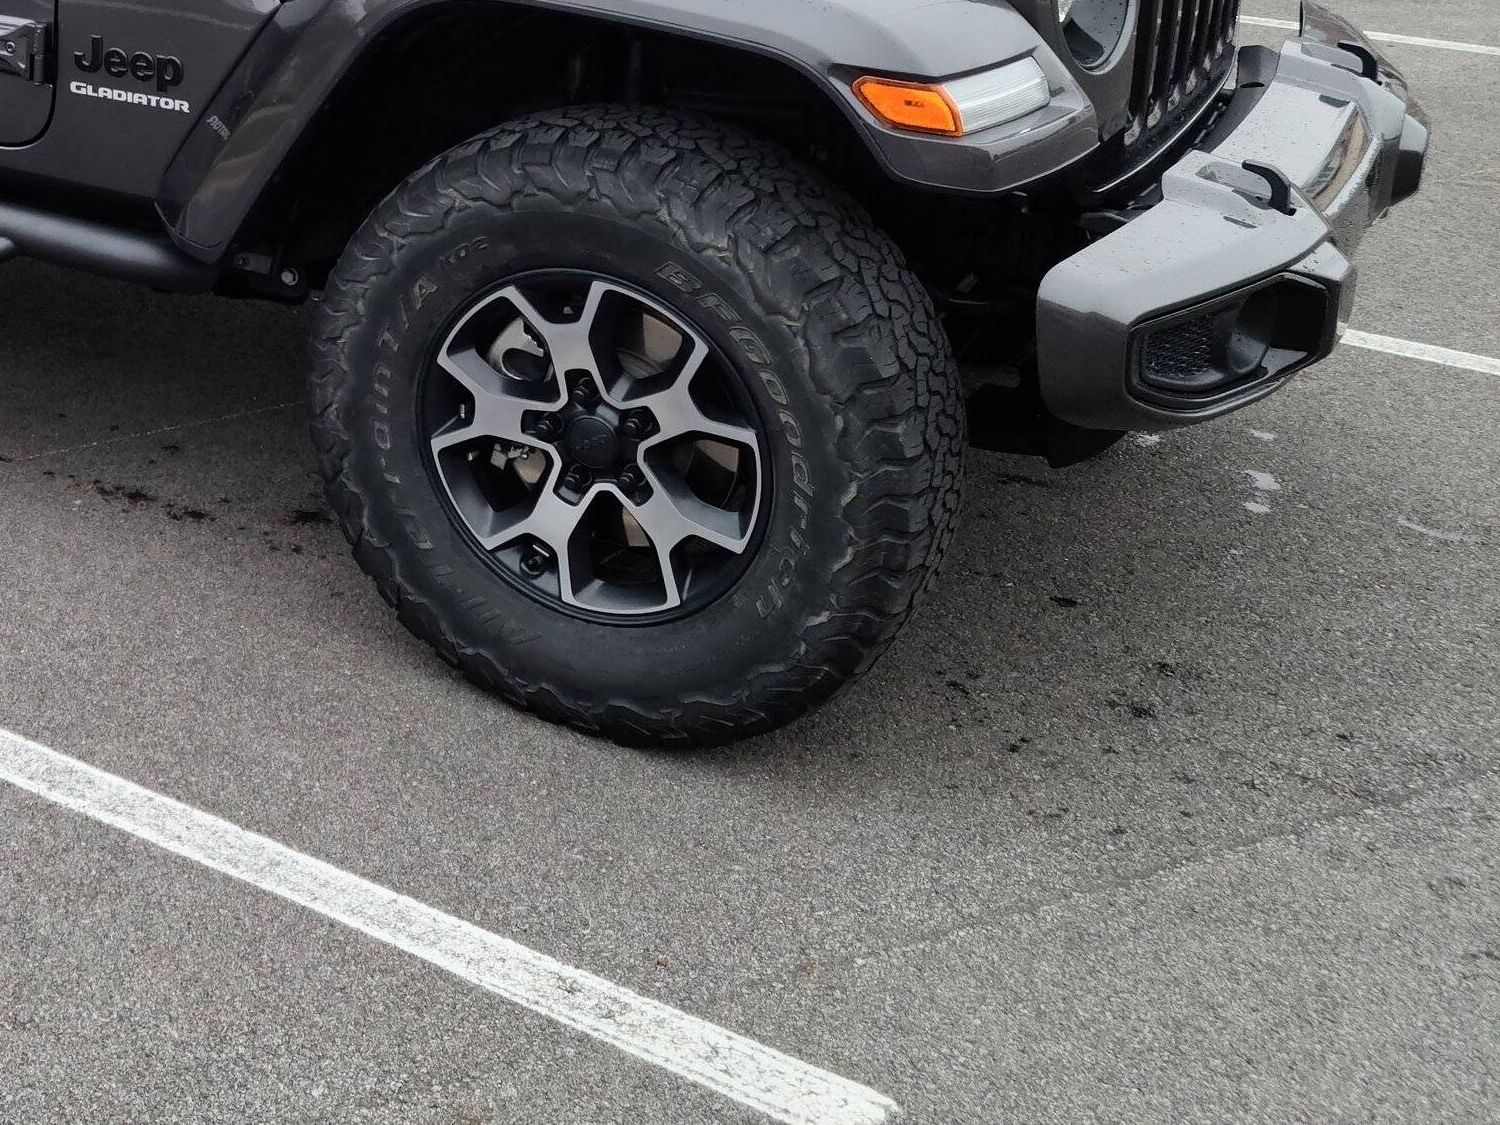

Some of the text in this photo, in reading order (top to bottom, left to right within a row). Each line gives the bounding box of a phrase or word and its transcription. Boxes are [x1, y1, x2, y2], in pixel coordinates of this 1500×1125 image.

[73, 34, 184, 92] Jeep
[69, 80, 190, 113] GLADIATOR
[653, 260, 815, 620] BFGoodrich
